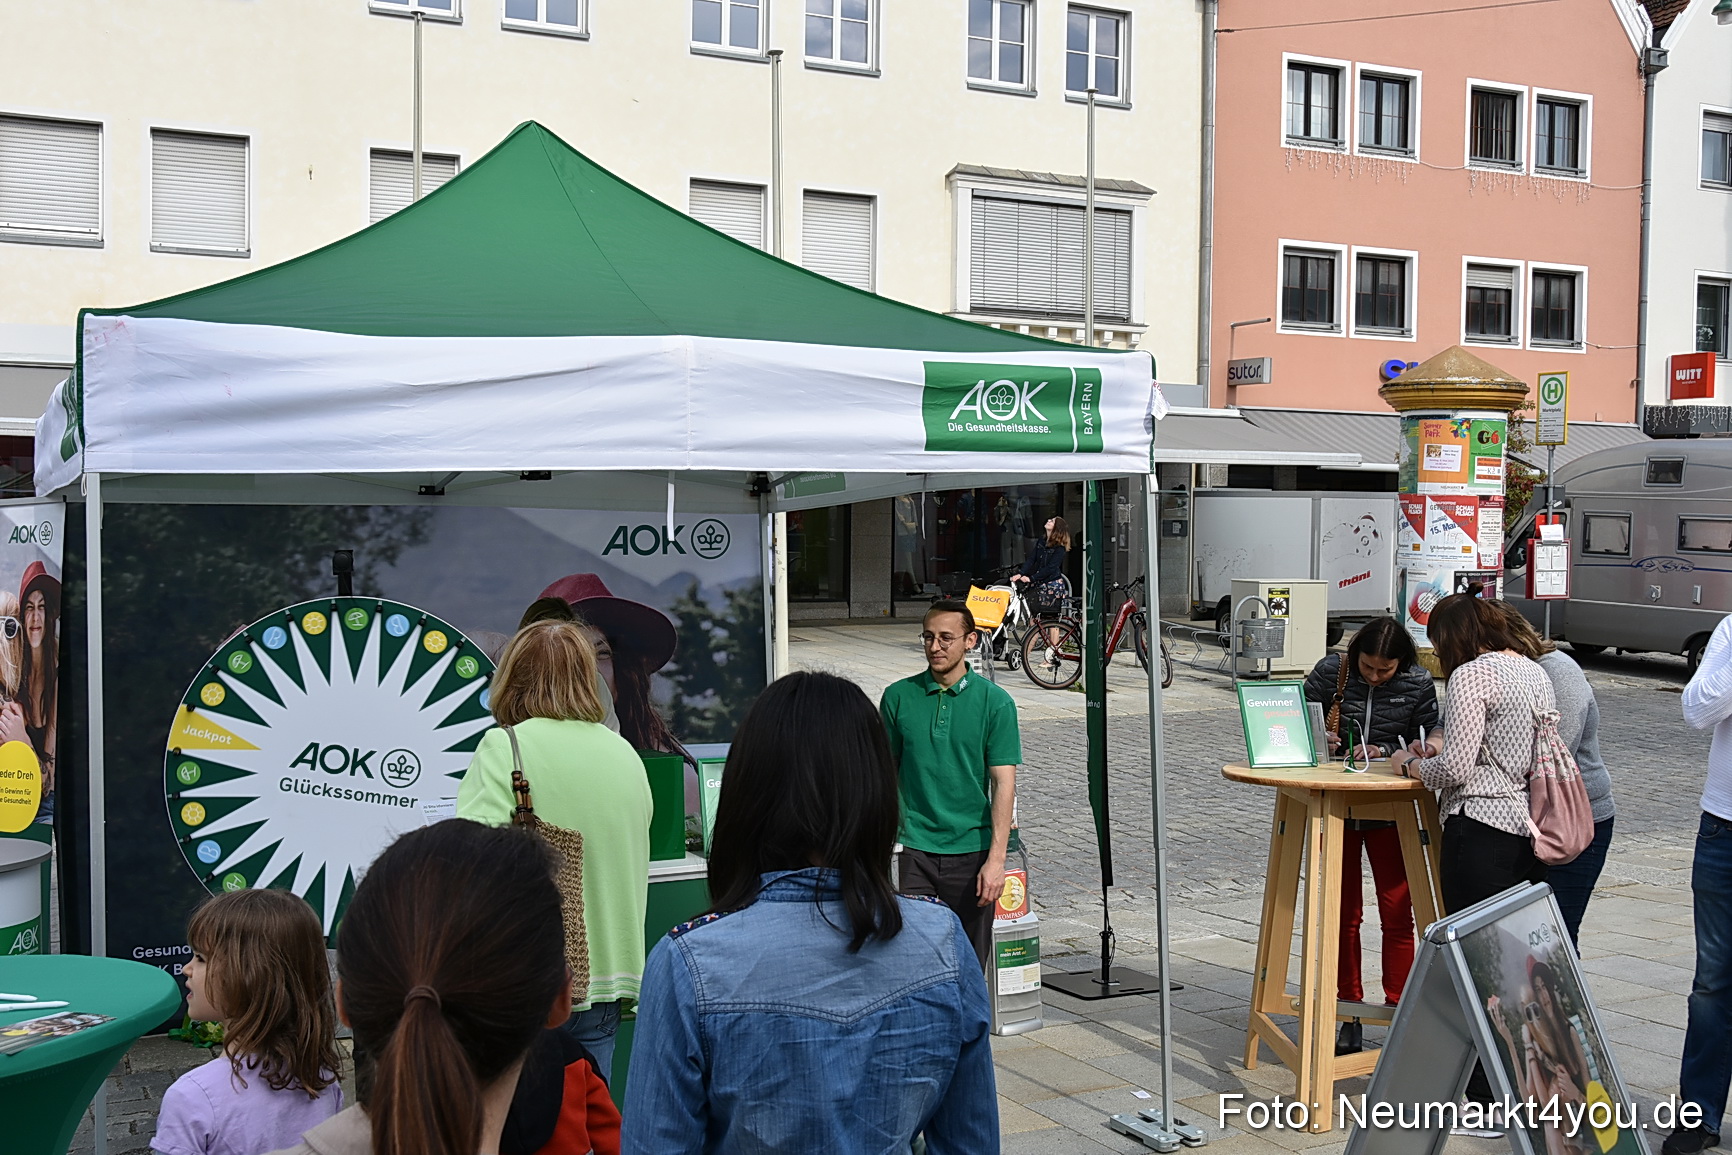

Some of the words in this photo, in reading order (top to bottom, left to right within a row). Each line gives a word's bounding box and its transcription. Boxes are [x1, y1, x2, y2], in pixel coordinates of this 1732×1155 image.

[1228, 363, 1262, 380] sutor.
[1676, 368, 1702, 381] WITT
[949, 379, 1049, 421] AOK
[1080, 382, 1094, 435] BAYERN
[948, 423, 963, 432] Die
[965, 422, 1052, 434] Gesundheitskasse.
[1477, 430, 1500, 445] G6
[8, 525, 38, 544] AOK
[1442, 522, 1457, 532] Mai
[601, 524, 687, 556] AOK
[1246, 698, 1294, 708] Gewinner
[1263, 708, 1301, 720] gesucht
[182, 724, 233, 745] Jackpot
[288, 741, 378, 779] AOK
[0, 769, 16, 779] eder
[17, 770, 34, 780] Dreh
[278, 776, 419, 809] Glückssommer
[9, 925, 39, 955] AOK
[133, 945, 192, 959] Gesund
